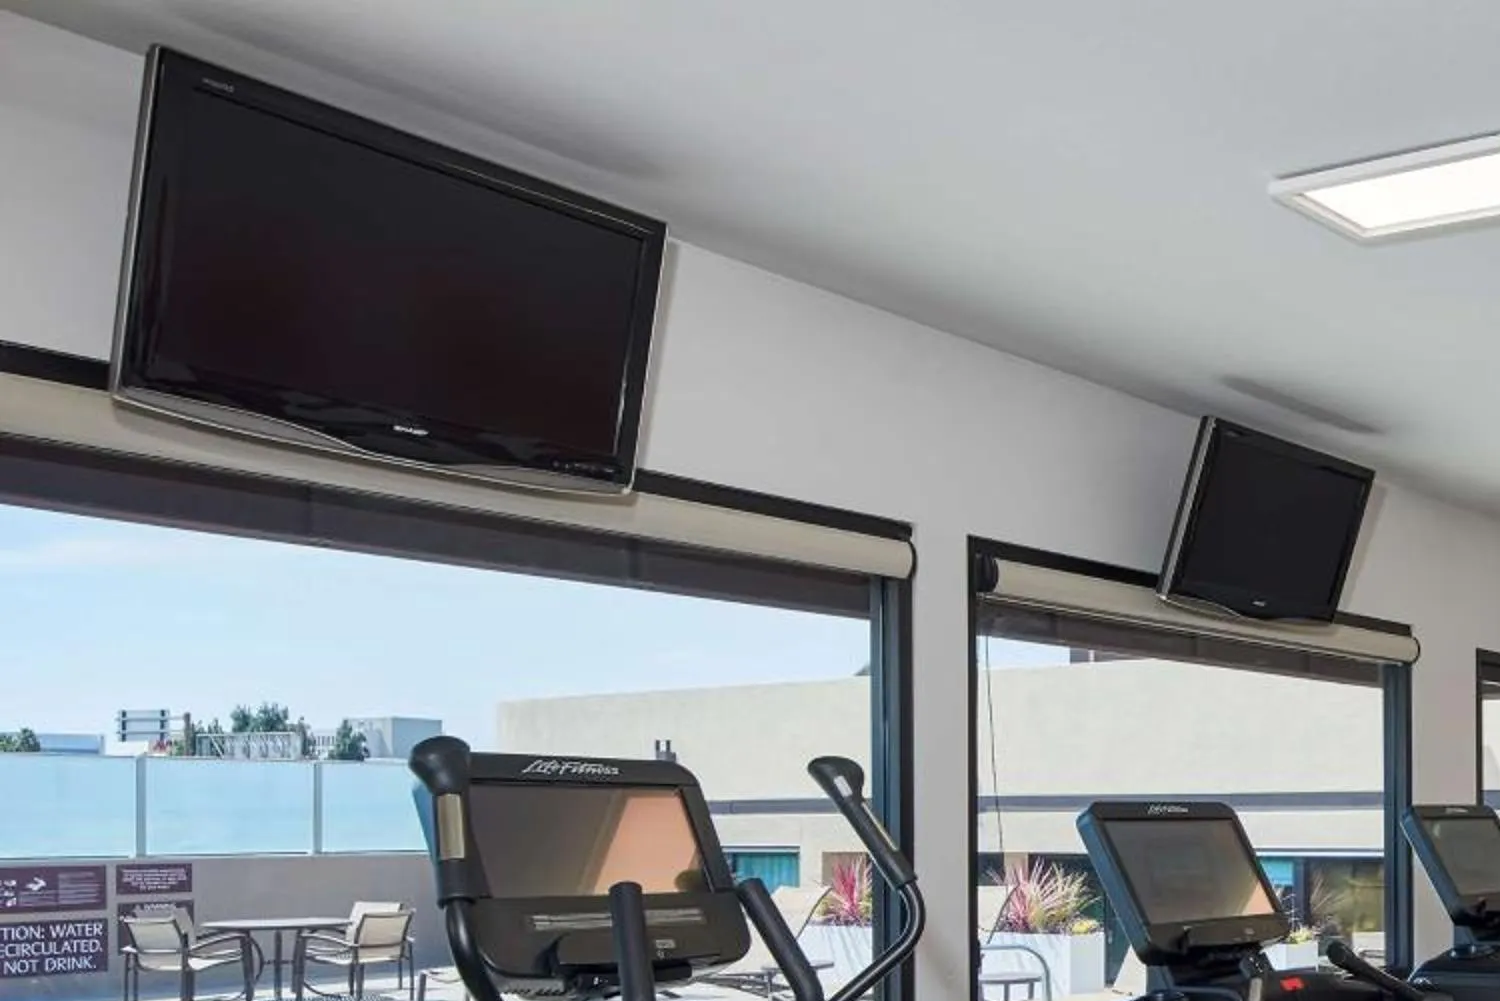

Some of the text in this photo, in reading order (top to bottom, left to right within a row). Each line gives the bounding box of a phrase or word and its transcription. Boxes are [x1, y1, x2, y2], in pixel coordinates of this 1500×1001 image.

[49, 922, 103, 939] WATER
[3, 955, 97, 976] NOT DRINK.
